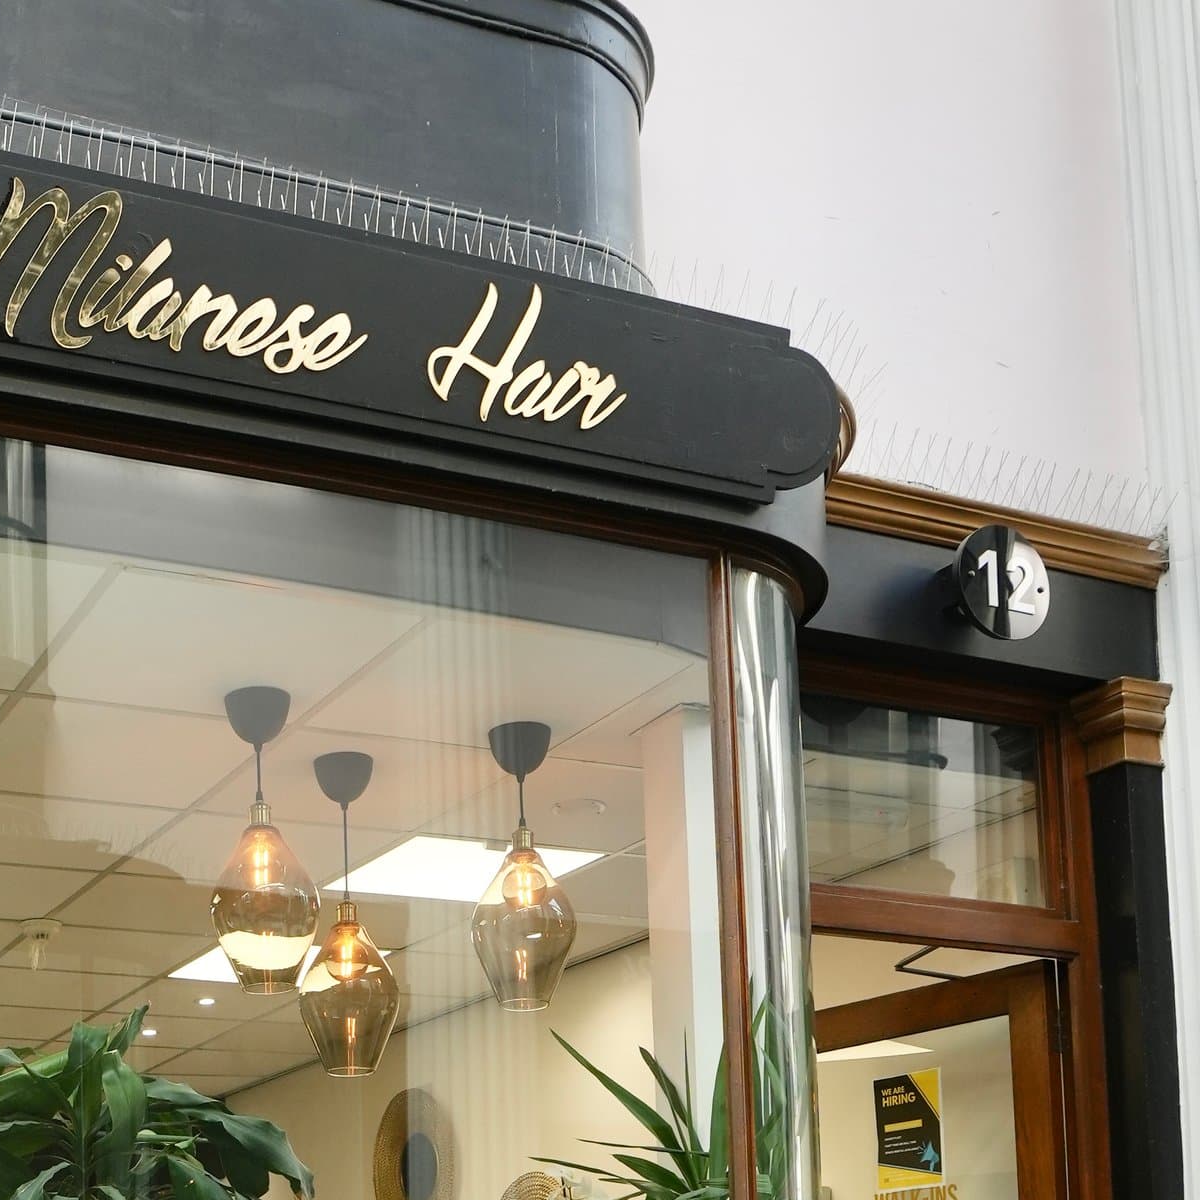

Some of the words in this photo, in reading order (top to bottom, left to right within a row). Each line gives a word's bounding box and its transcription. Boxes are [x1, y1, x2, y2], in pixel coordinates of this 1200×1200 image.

[427, 281, 628, 431] Hair
[977, 549, 1036, 615] 12
[881, 1088, 892, 1096] WE
[893, 1086, 905, 1094] ARE
[882, 1092, 916, 1108] HIRING
